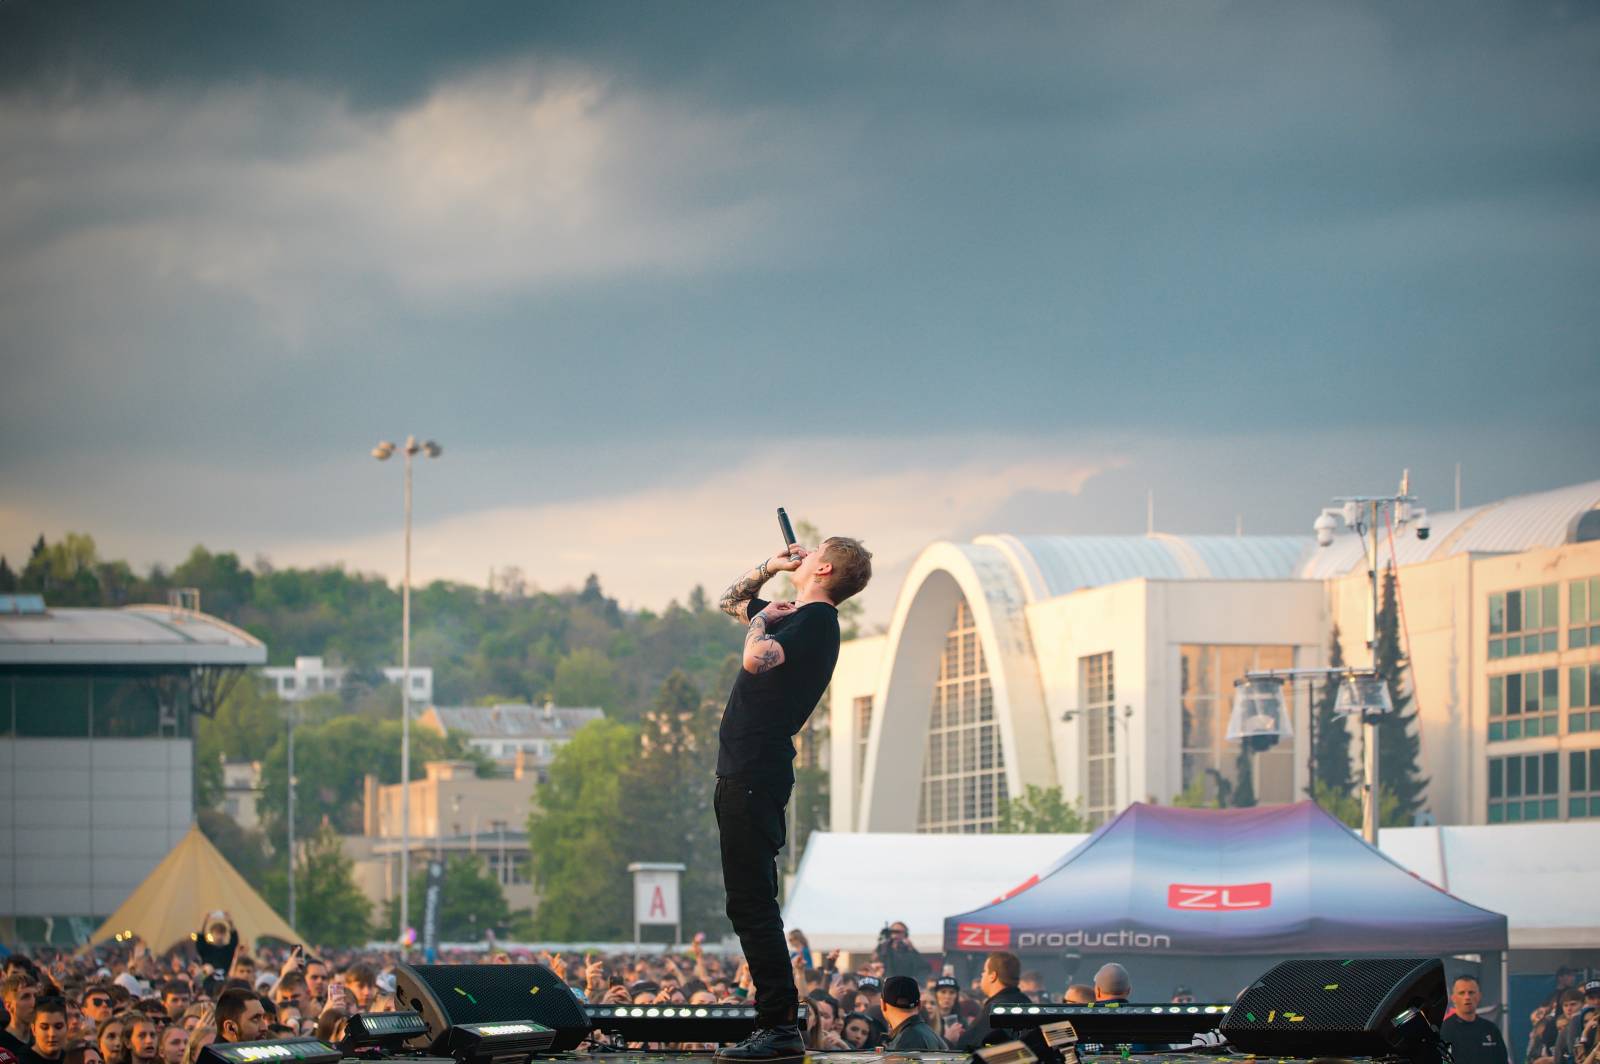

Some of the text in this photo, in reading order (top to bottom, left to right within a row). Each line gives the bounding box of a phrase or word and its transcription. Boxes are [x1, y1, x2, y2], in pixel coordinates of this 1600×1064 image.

[650, 885, 667, 917] A
[1178, 888, 1261, 908] ZL
[961, 926, 1171, 948] ZL production
